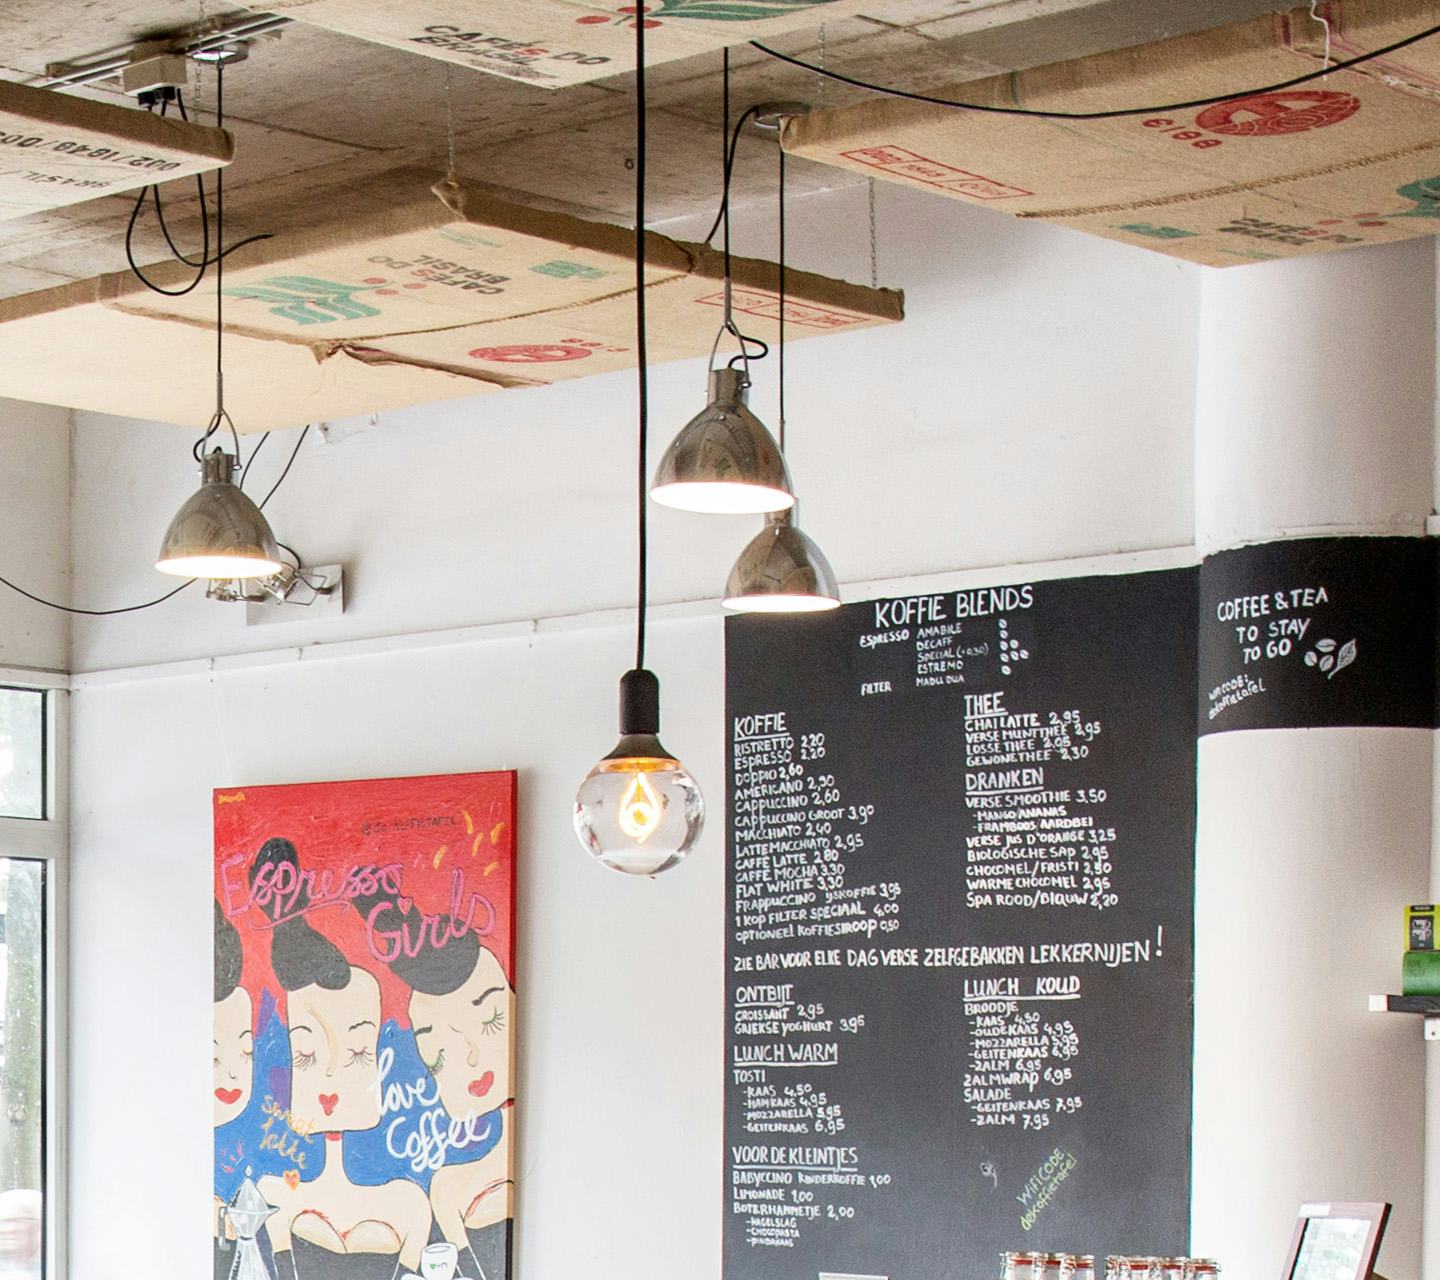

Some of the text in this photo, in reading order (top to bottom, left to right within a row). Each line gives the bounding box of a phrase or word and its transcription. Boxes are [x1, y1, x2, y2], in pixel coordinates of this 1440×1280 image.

[875, 586, 1033, 628] KOFFIE BLENDS
[1217, 587, 1328, 621] COFFEE & TEA
[859, 623, 962, 648] ESPRESSO AMABILE
[1236, 618, 1311, 643] TO STAY
[917, 637, 953, 650] DECAFF
[1243, 639, 1291, 664] TO GO
[917, 661, 963, 674] ESTREMO
[861, 681, 891, 695] FILTER
[964, 692, 1006, 716] THEE
[735, 712, 787, 738] KOFFIE
[966, 730, 999, 743] VERSE
[735, 738, 794, 757] RISTRETTO
[967, 739, 1034, 755] LOSSE THEE
[735, 750, 792, 771] ESPRESSO
[966, 768, 1043, 790] DRANKEN
[735, 781, 803, 800] AMERICANO
[966, 795, 1002, 808] VERSE
[1005, 790, 1070, 807] SMOOTHIE
[736, 795, 807, 815] CAPPUCCINO
[736, 825, 801, 843] MACCHIATO
[968, 848, 1046, 861] BIOLOGISCHE
[767, 879, 814, 893] WHITE
[756, 953, 779, 970] BAR
[780, 952, 812, 969] VOOR
[815, 950, 841, 966] ELKE
[847, 950, 877, 967] DAG
[880, 949, 918, 966] VERSE
[924, 946, 1024, 967] ZELFGEBAKKEN
[964, 976, 1080, 996] LUNCH KOUD
[964, 1002, 1019, 1017] BROODJE
[734, 1043, 838, 1062] LUNCH WARM
[733, 1070, 765, 1084] TOSTI
[964, 1089, 1011, 1101] SALADE
[733, 1147, 768, 1164] VOOR
[771, 1147, 786, 1164] DE
[733, 1187, 785, 1201] LIMONADE
